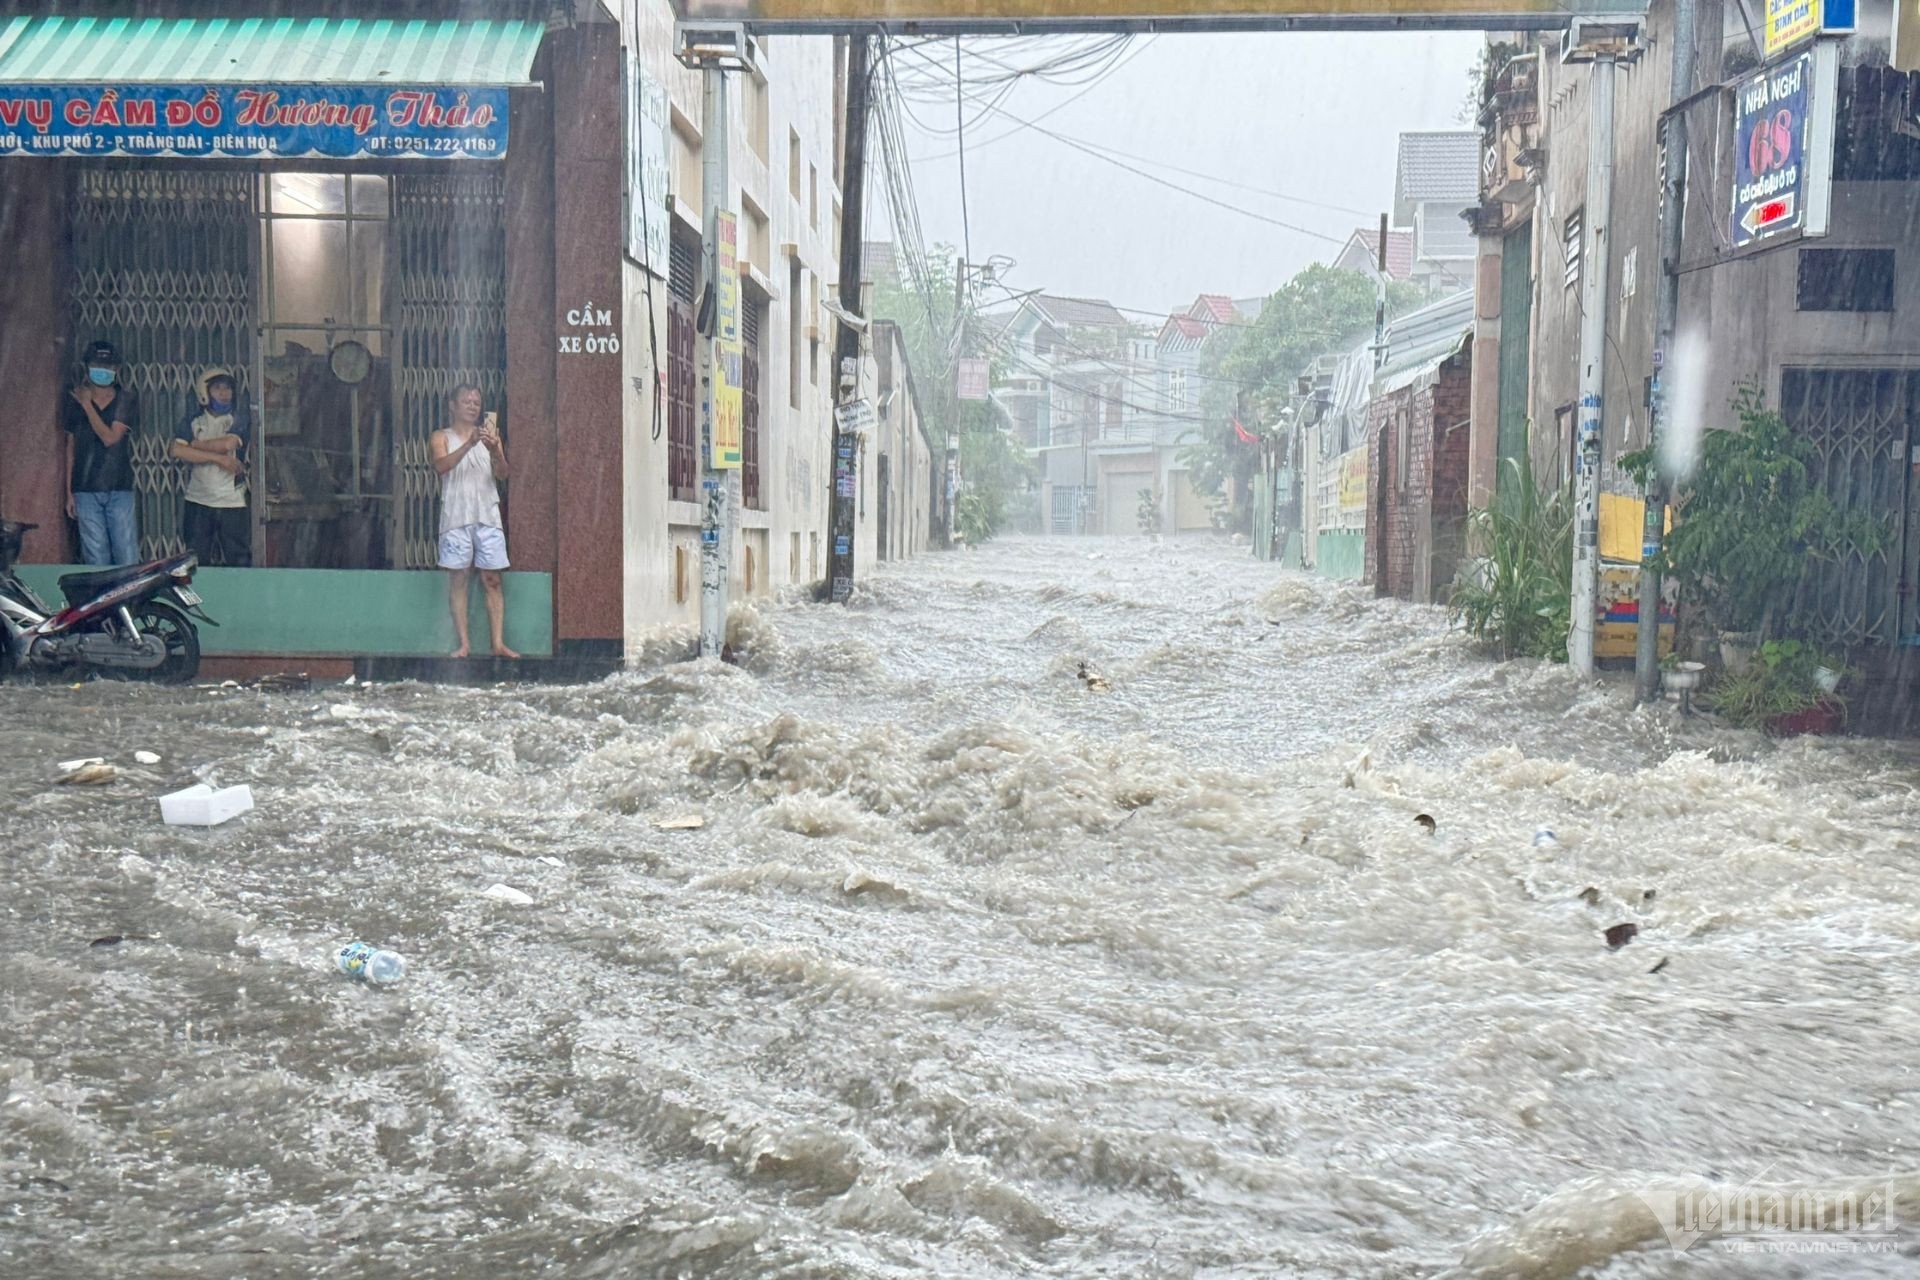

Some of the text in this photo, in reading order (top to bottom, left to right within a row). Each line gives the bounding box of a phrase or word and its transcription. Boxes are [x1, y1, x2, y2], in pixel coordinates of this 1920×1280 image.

[0, 88, 497, 135] VỤ CẦM ĐỒ Hương Thảo
[33, 135, 60, 148] KHU
[63, 132, 92, 148] PHỐ
[95, 135, 104, 148] 2
[213, 133, 244, 149] BIÊN
[247, 135, 277, 149] HÒA
[567, 301, 612, 326] CẦM
[559, 336, 582, 353] XE
